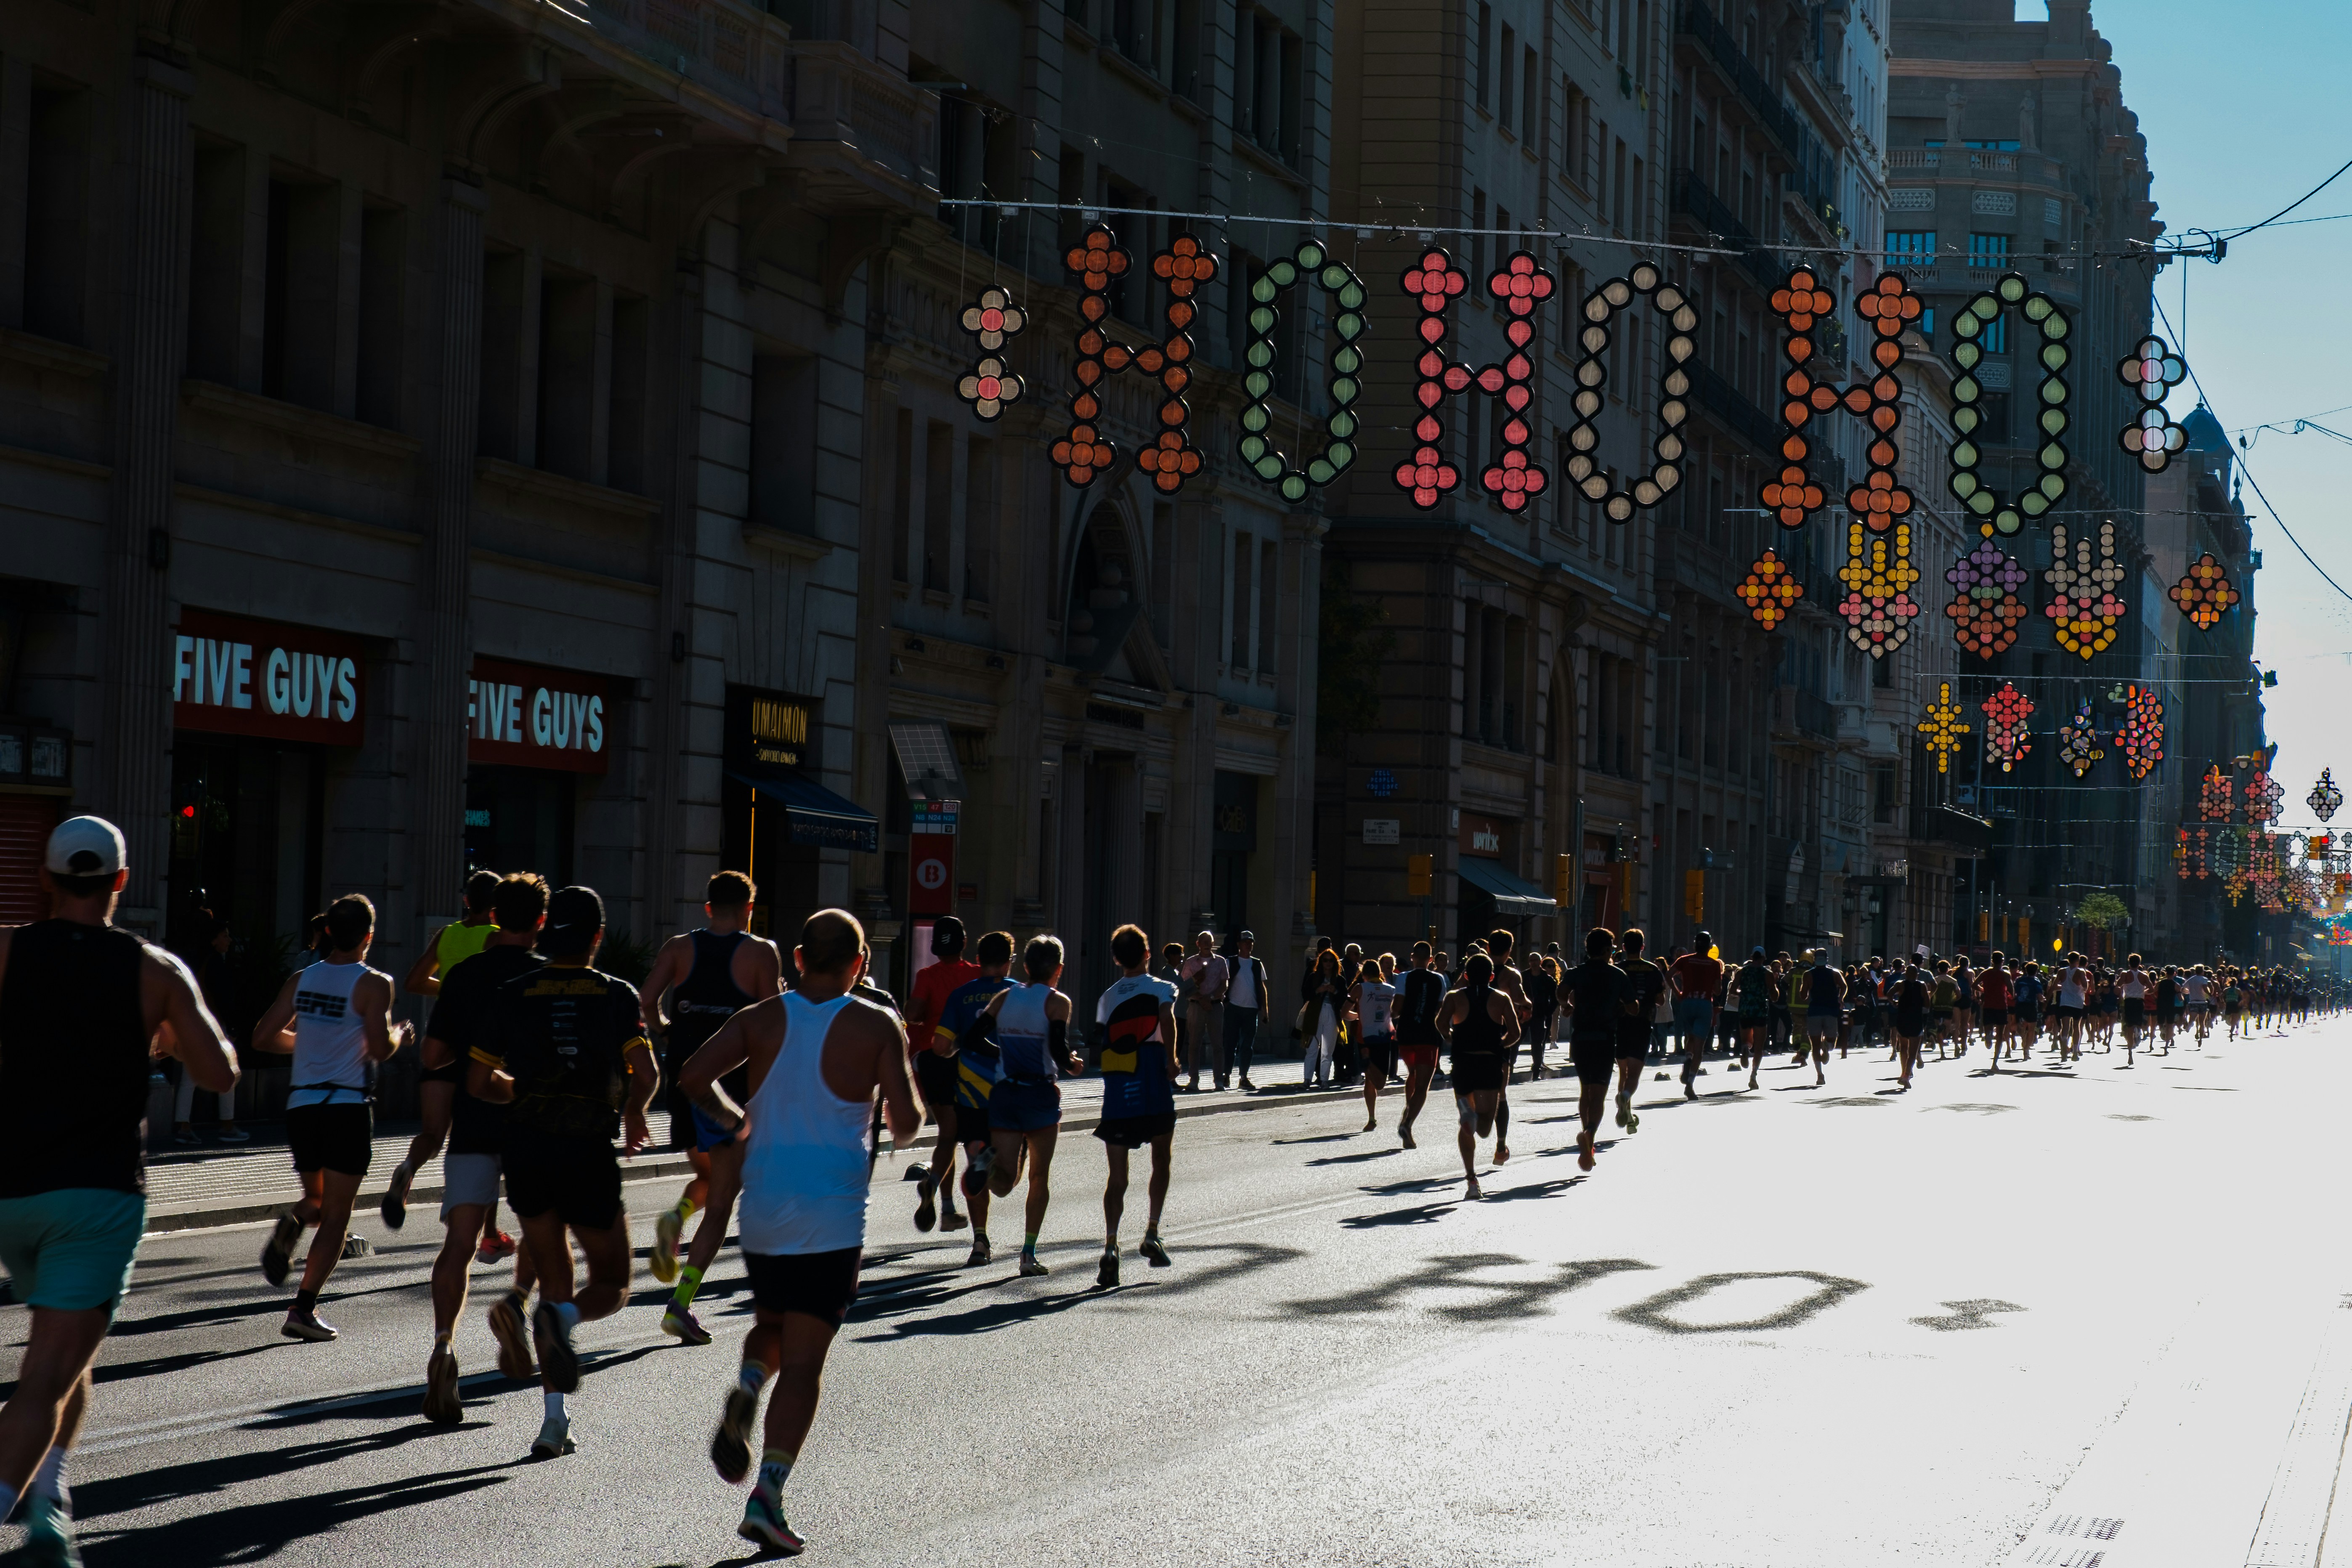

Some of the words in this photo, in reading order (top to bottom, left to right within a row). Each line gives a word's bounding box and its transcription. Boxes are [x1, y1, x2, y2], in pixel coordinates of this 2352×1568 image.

[174, 634, 252, 709] FIVE
[266, 647, 356, 723] GUYS
[532, 687, 603, 752] GUYS
[752, 697, 807, 746] UMAIMON
